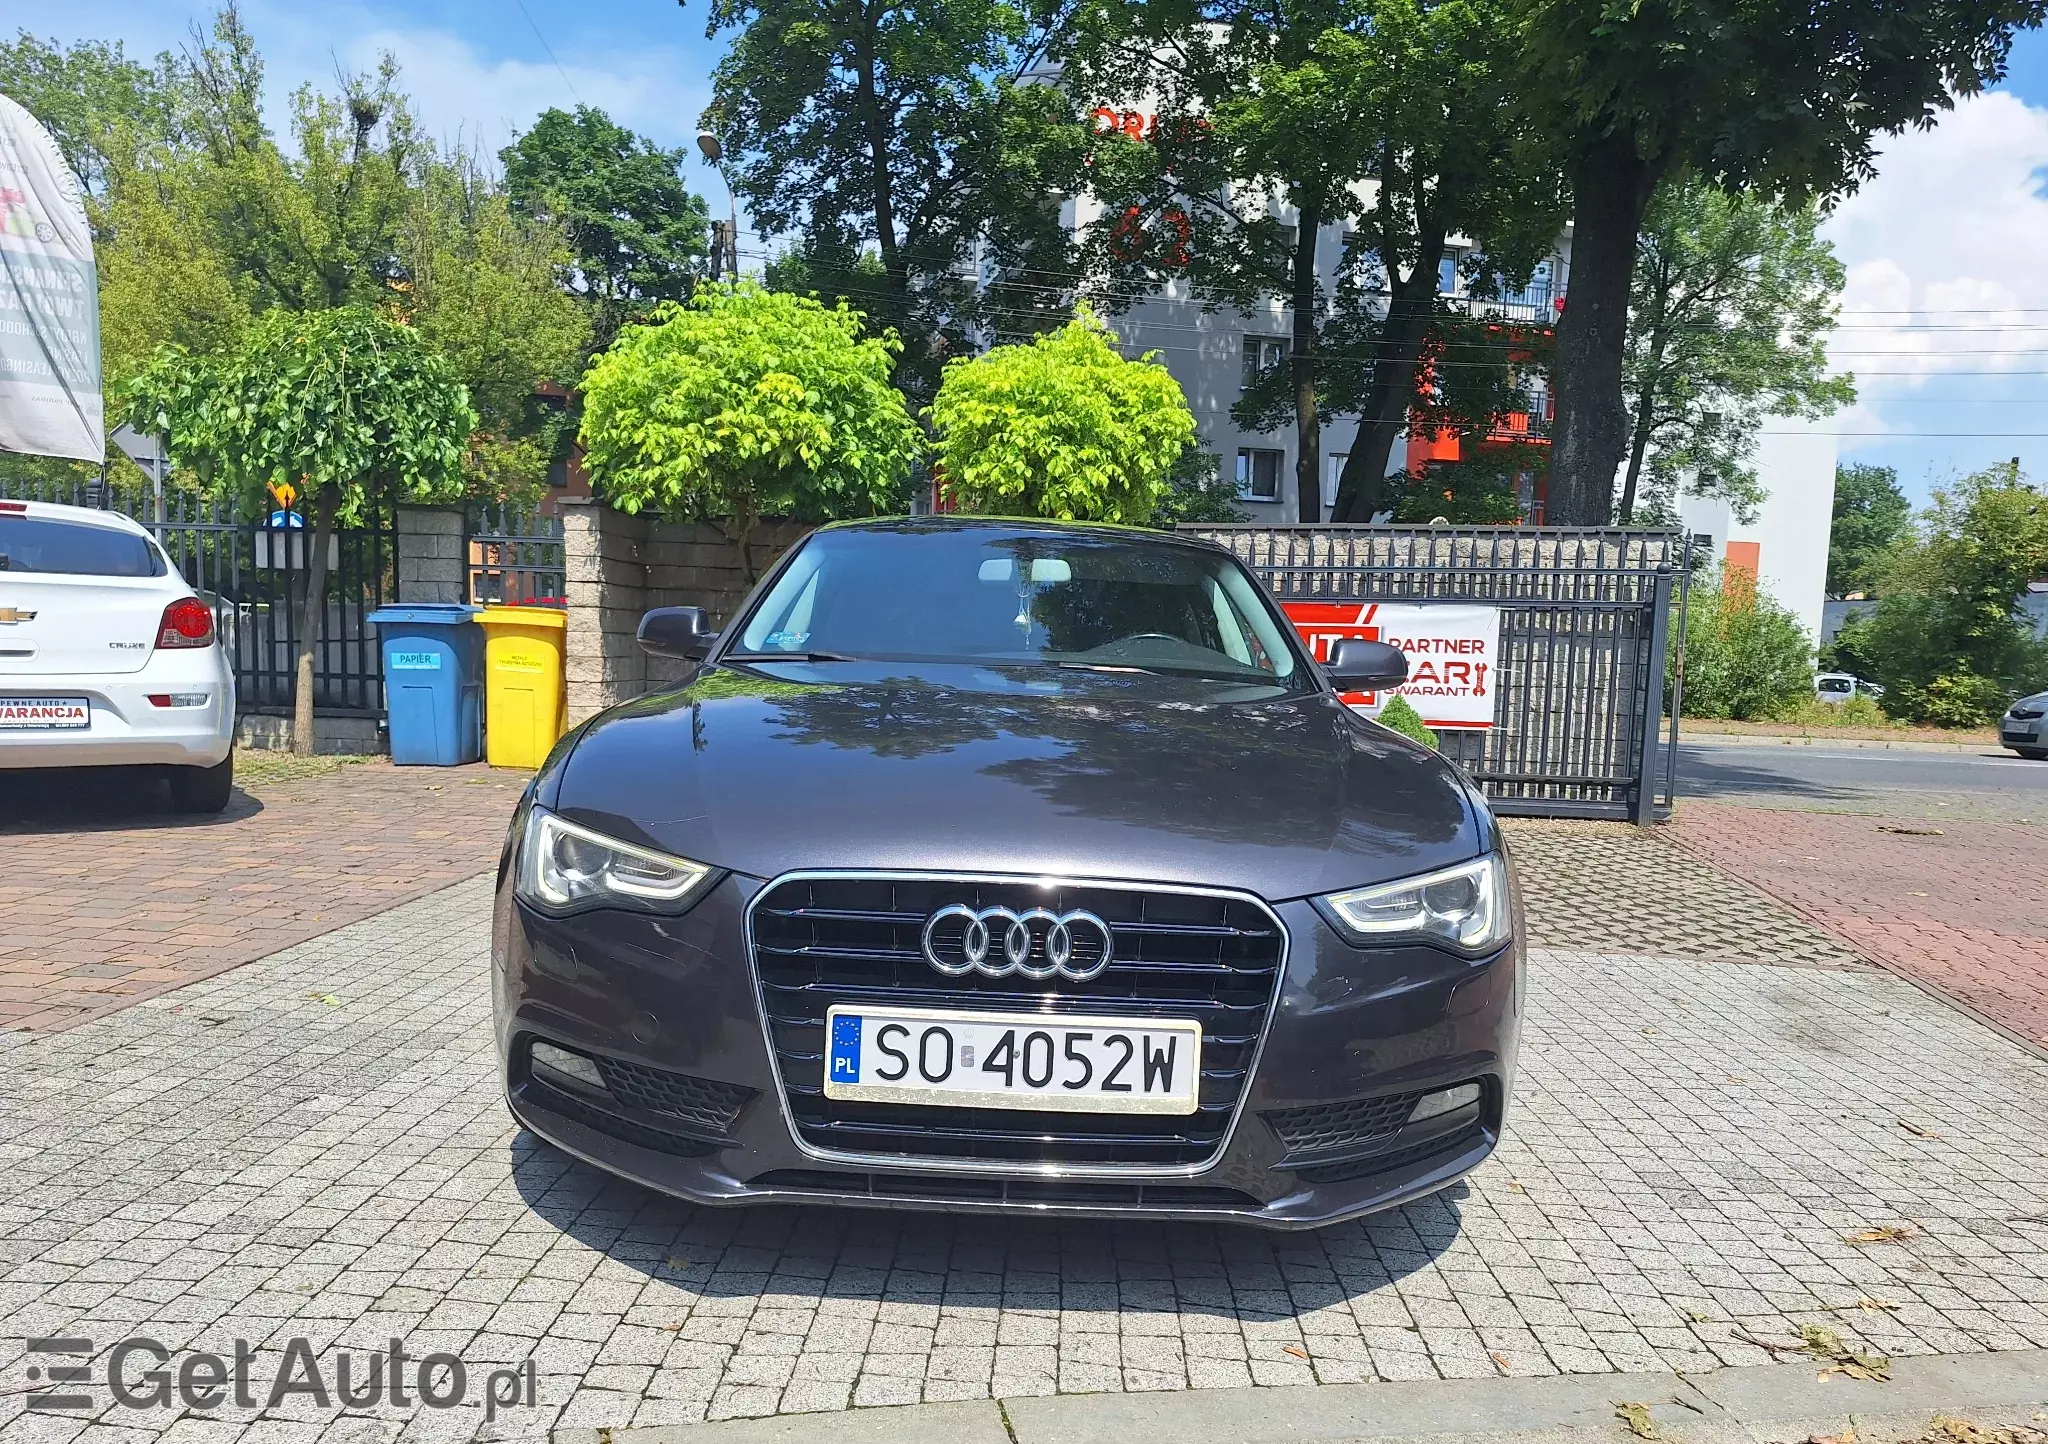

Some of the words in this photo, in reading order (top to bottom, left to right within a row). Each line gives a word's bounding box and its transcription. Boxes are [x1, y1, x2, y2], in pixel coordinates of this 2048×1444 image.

[400, 654, 432, 664] PAPIER
[1405, 661, 1471, 685] AR
[835, 1057, 856, 1074] PL
[876, 1023, 954, 1083] SO
[982, 1029, 1177, 1093] 4052W
